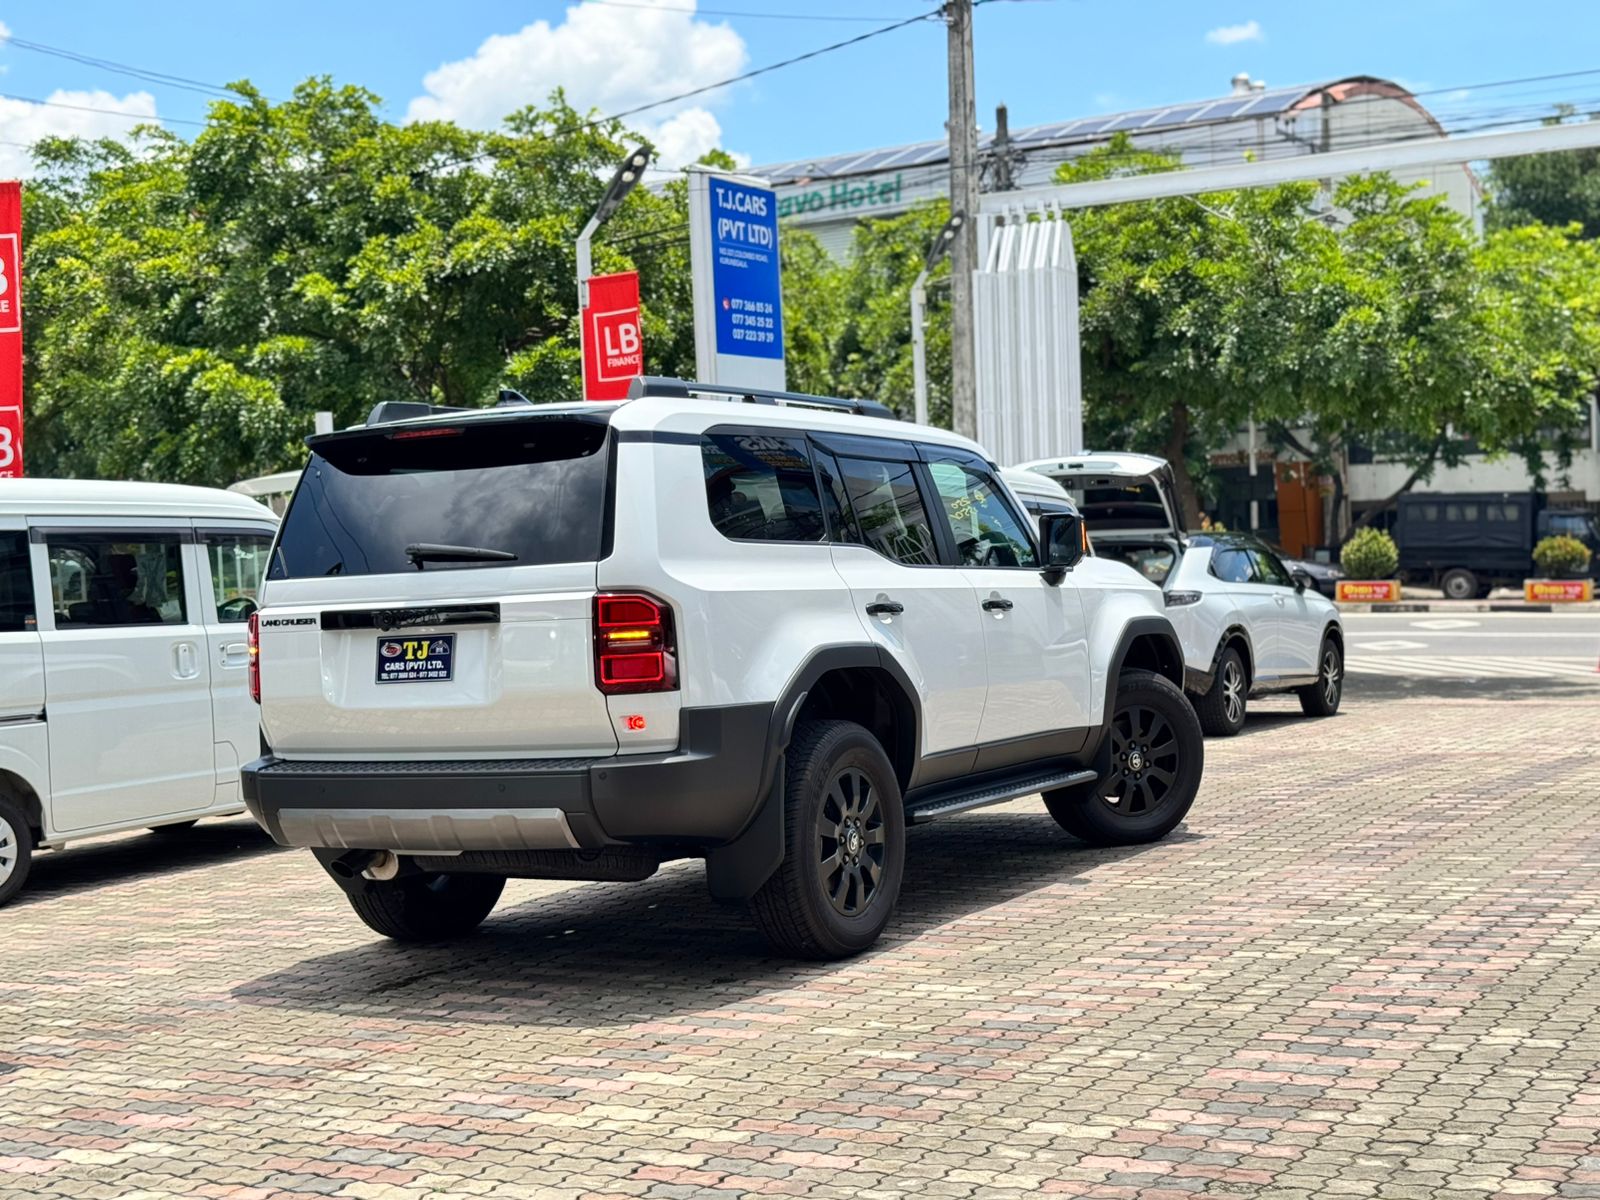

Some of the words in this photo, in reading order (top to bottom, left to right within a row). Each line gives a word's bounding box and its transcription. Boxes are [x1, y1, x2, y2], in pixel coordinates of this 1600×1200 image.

[716, 187, 767, 217] T.J.CARS
[830, 174, 902, 209] Hotel
[717, 217, 746, 241] (PVT
[748, 223, 773, 249] LTD)
[604, 323, 639, 356] LB
[607, 354, 640, 368] FINANCE
[261, 619, 281, 627] LAND
[281, 618, 317, 626] CRUISER
[403, 640, 430, 660] TJ
[384, 662, 405, 671] CARS
[406, 660, 426, 671] (PVT)
[427, 660, 444, 669] LTD.
